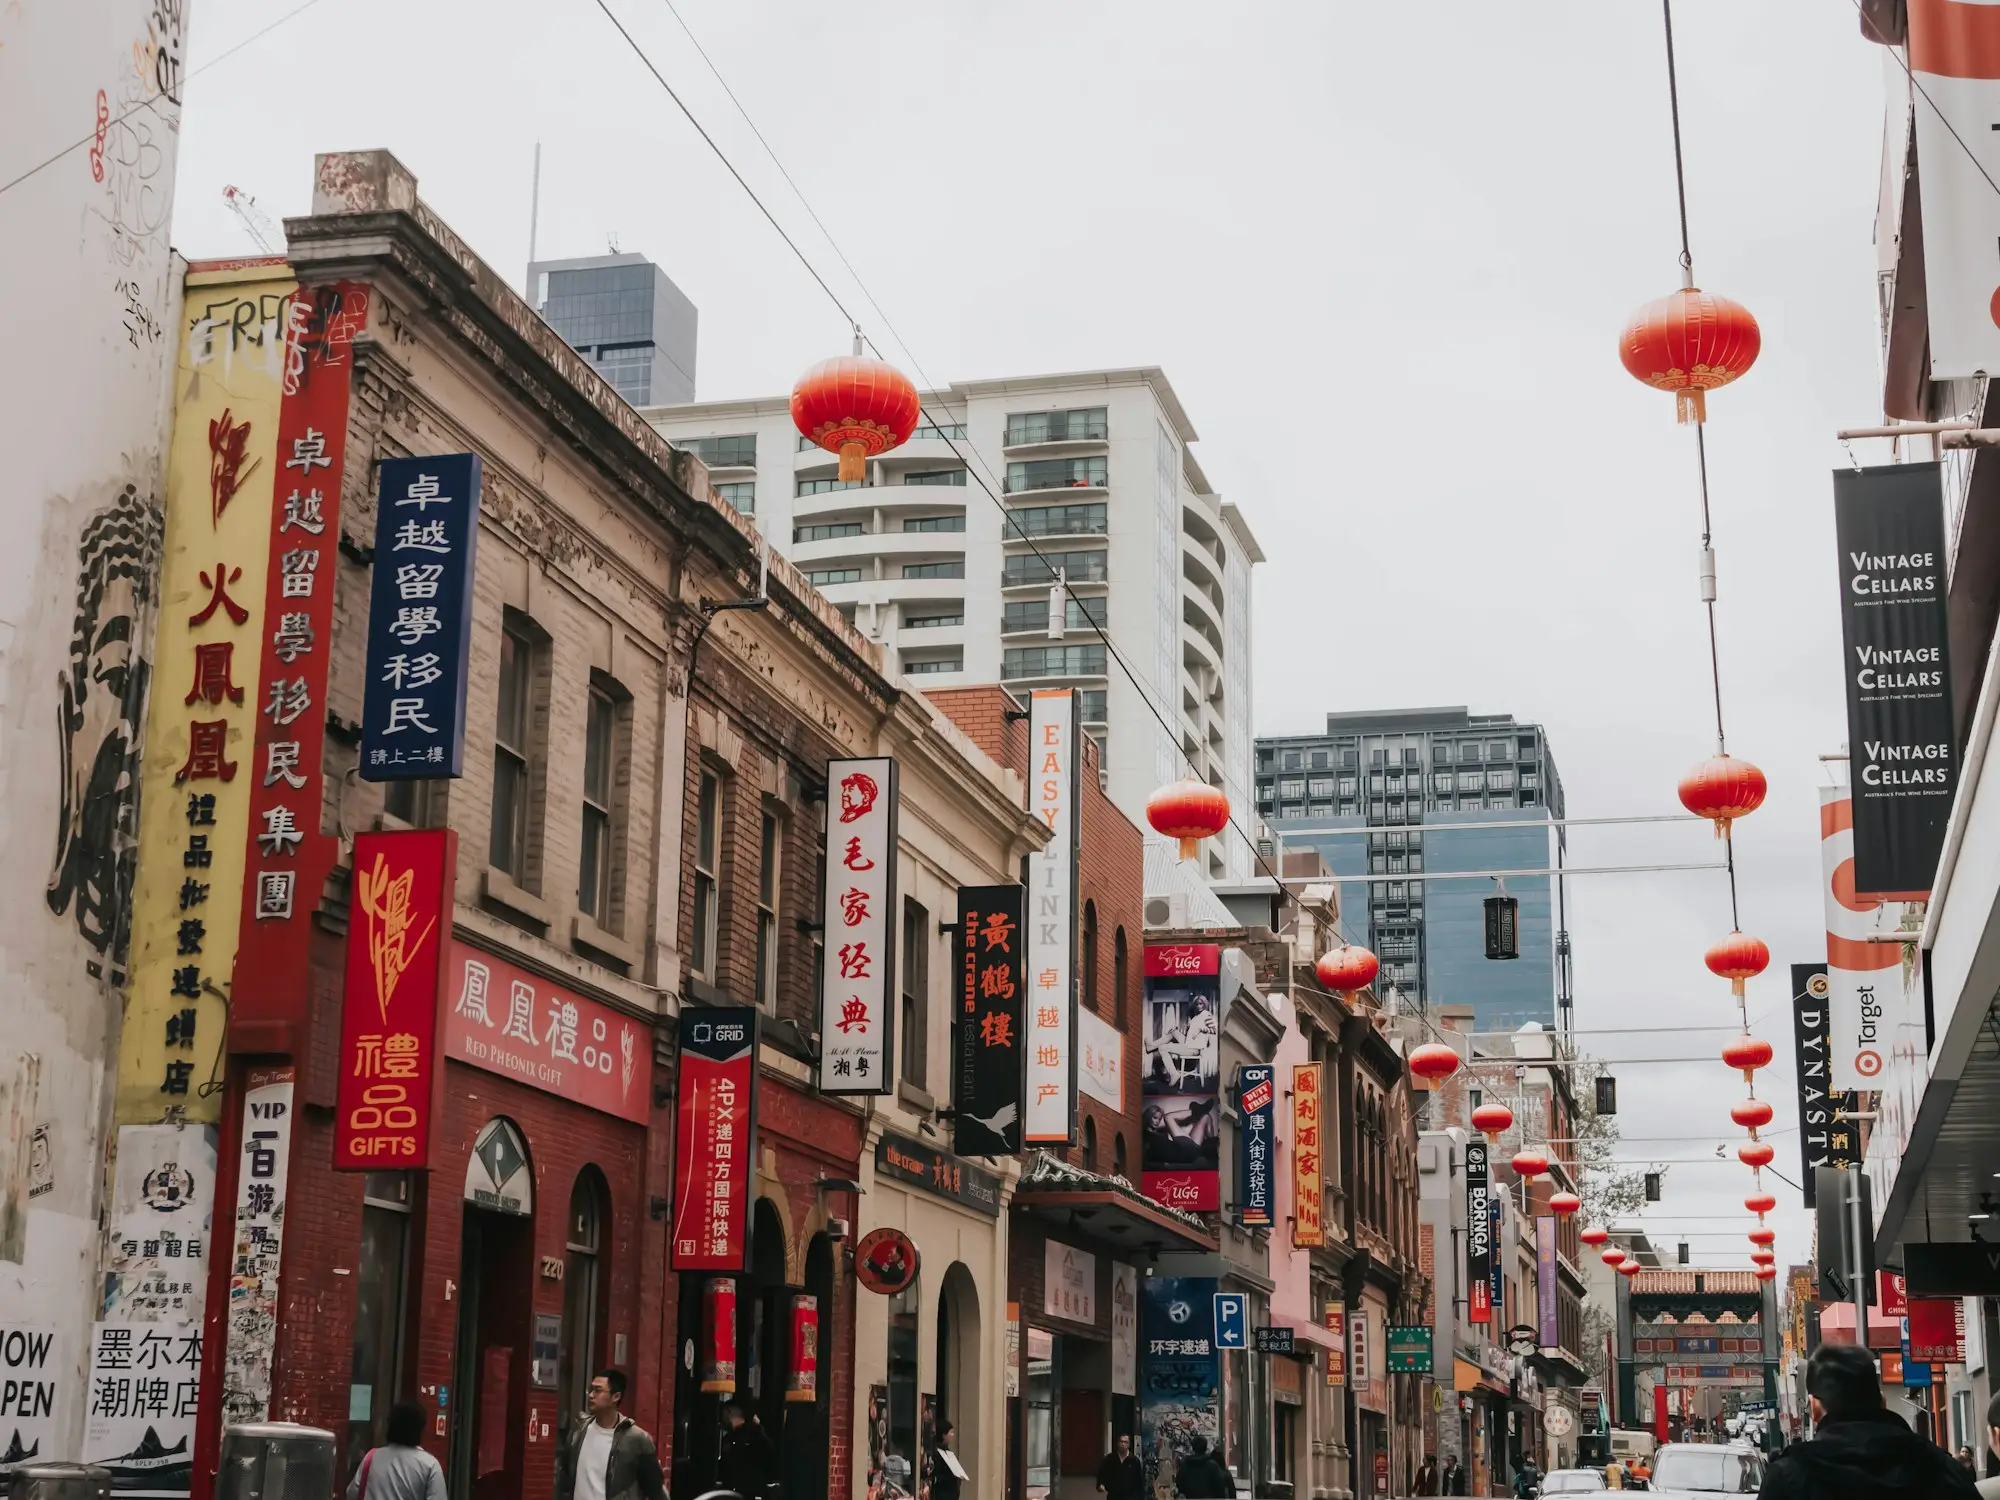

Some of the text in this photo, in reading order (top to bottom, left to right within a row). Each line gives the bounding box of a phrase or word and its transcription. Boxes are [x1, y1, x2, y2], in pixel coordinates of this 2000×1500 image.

[1850, 551, 1933, 571] VINTAGE
[1852, 574, 1935, 595] CELLARS
[381, 473, 452, 736] 卓越留學移民
[1856, 645, 1939, 665] VINTAGE
[172, 562, 250, 784] 火鳳凰
[256, 427, 332, 919] 卓越留學移民集團
[1857, 668, 1941, 689] CELLARS
[369, 746, 445, 767] 請上二樓
[1864, 741, 1948, 761] VINTAGE
[1862, 764, 1947, 785] CELLARS
[834, 837, 875, 1034] 毛家经典
[455, 959, 612, 1076] 鳳凰禮品
[963, 910, 979, 1102] the crane restaurant
[1857, 985, 1882, 1048] Target
[716, 1030, 744, 1041] GRID
[1036, 967, 1060, 1106] 卓越地产
[466, 1035, 487, 1058] RED
[538, 1063, 562, 1087] GIFT
[350, 1033, 419, 1130] 禮品
[1247, 1084, 1268, 1102] DUTY
[250, 1102, 286, 1119] VIP
[1248, 1094, 1271, 1111] FREE
[349, 1136, 416, 1157] GIFTS
[1249, 1114, 1266, 1207] 唐人街免税店
[1297, 1180, 1319, 1207] LING
[1299, 1204, 1318, 1228] NAN
[1472, 1187, 1488, 1257] BORNGA
[542, 1256, 564, 1281] 220
[1221, 1301, 1238, 1322] P
[1150, 1339, 1210, 1355] 环宇速递
[1259, 1330, 1290, 1340] 唐人街
[97, 1329, 204, 1371] 墨尔本
[92, 1376, 200, 1419] 潮牌店
